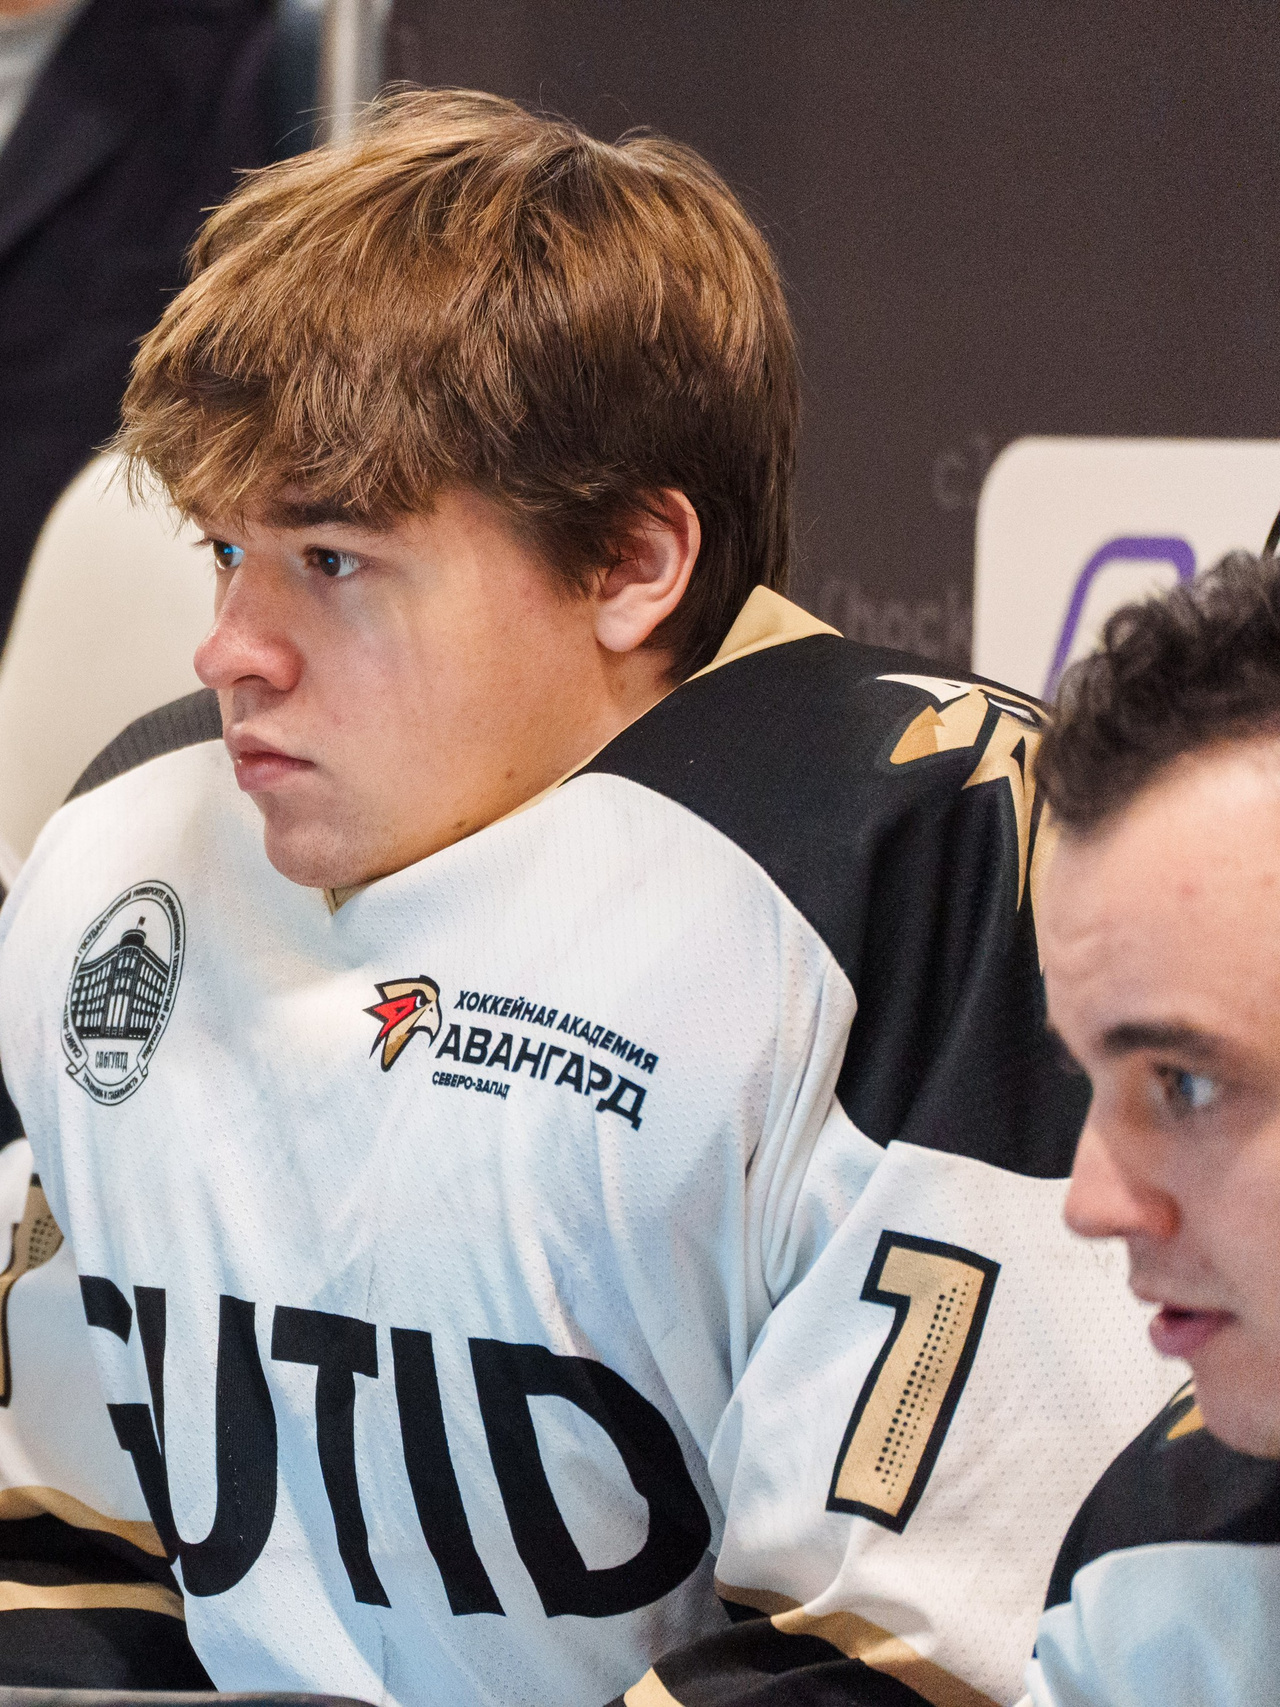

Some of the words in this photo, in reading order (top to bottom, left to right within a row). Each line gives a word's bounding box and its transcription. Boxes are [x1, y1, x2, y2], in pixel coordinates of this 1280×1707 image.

[434, 1023, 648, 1132] АВАНГАРД
[453, 990, 559, 1028] ХОККЕЙНАЯ
[557, 1013, 659, 1075] АКАДЕМИЯ
[825, 1228, 1002, 1535] 1
